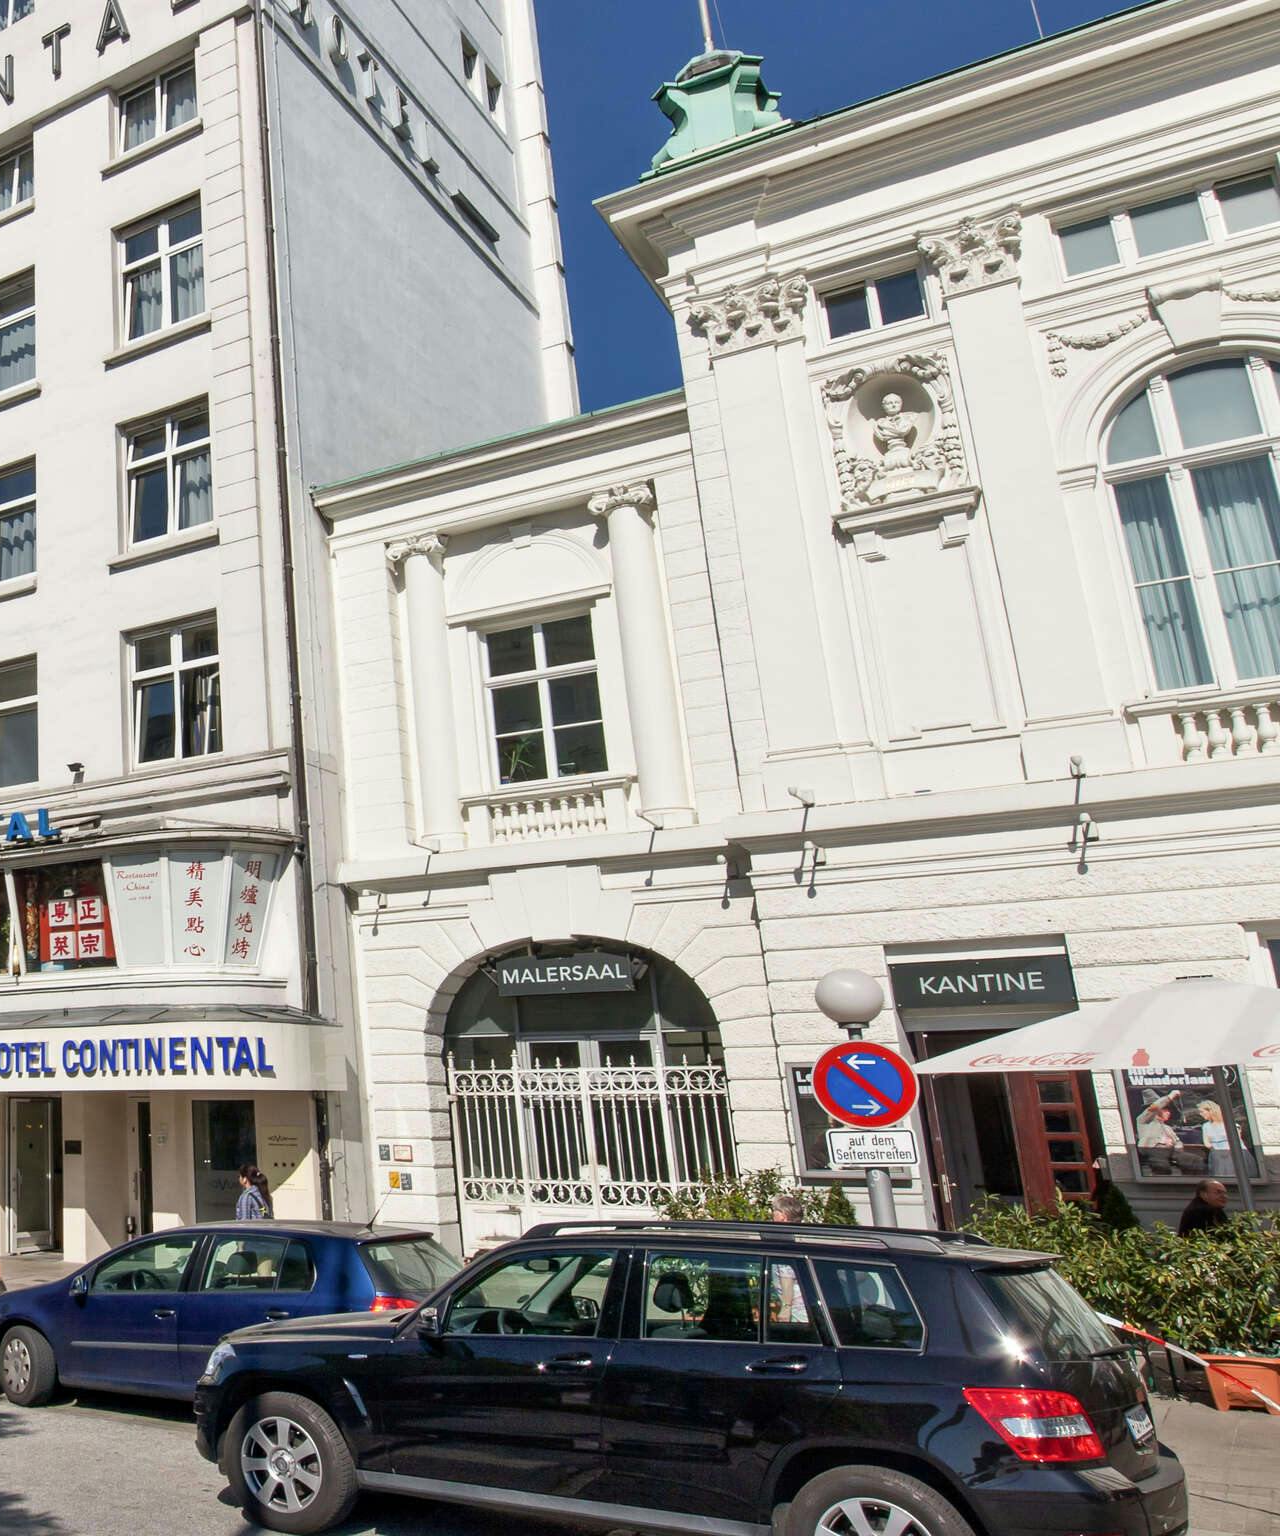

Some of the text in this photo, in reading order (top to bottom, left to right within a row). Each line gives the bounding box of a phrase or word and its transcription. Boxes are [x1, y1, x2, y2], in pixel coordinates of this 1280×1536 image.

[501, 962, 628, 985] MALERSAAL
[919, 970, 1046, 995] KANTINE
[62, 1036, 275, 1074] CONTINENTAL
[968, 1052, 1100, 1069] Coca-Cola
[1129, 1074, 1215, 1086] Wunderland
[849, 1135, 896, 1147] auf dem
[836, 1147, 913, 1161] Seitenstreifen
